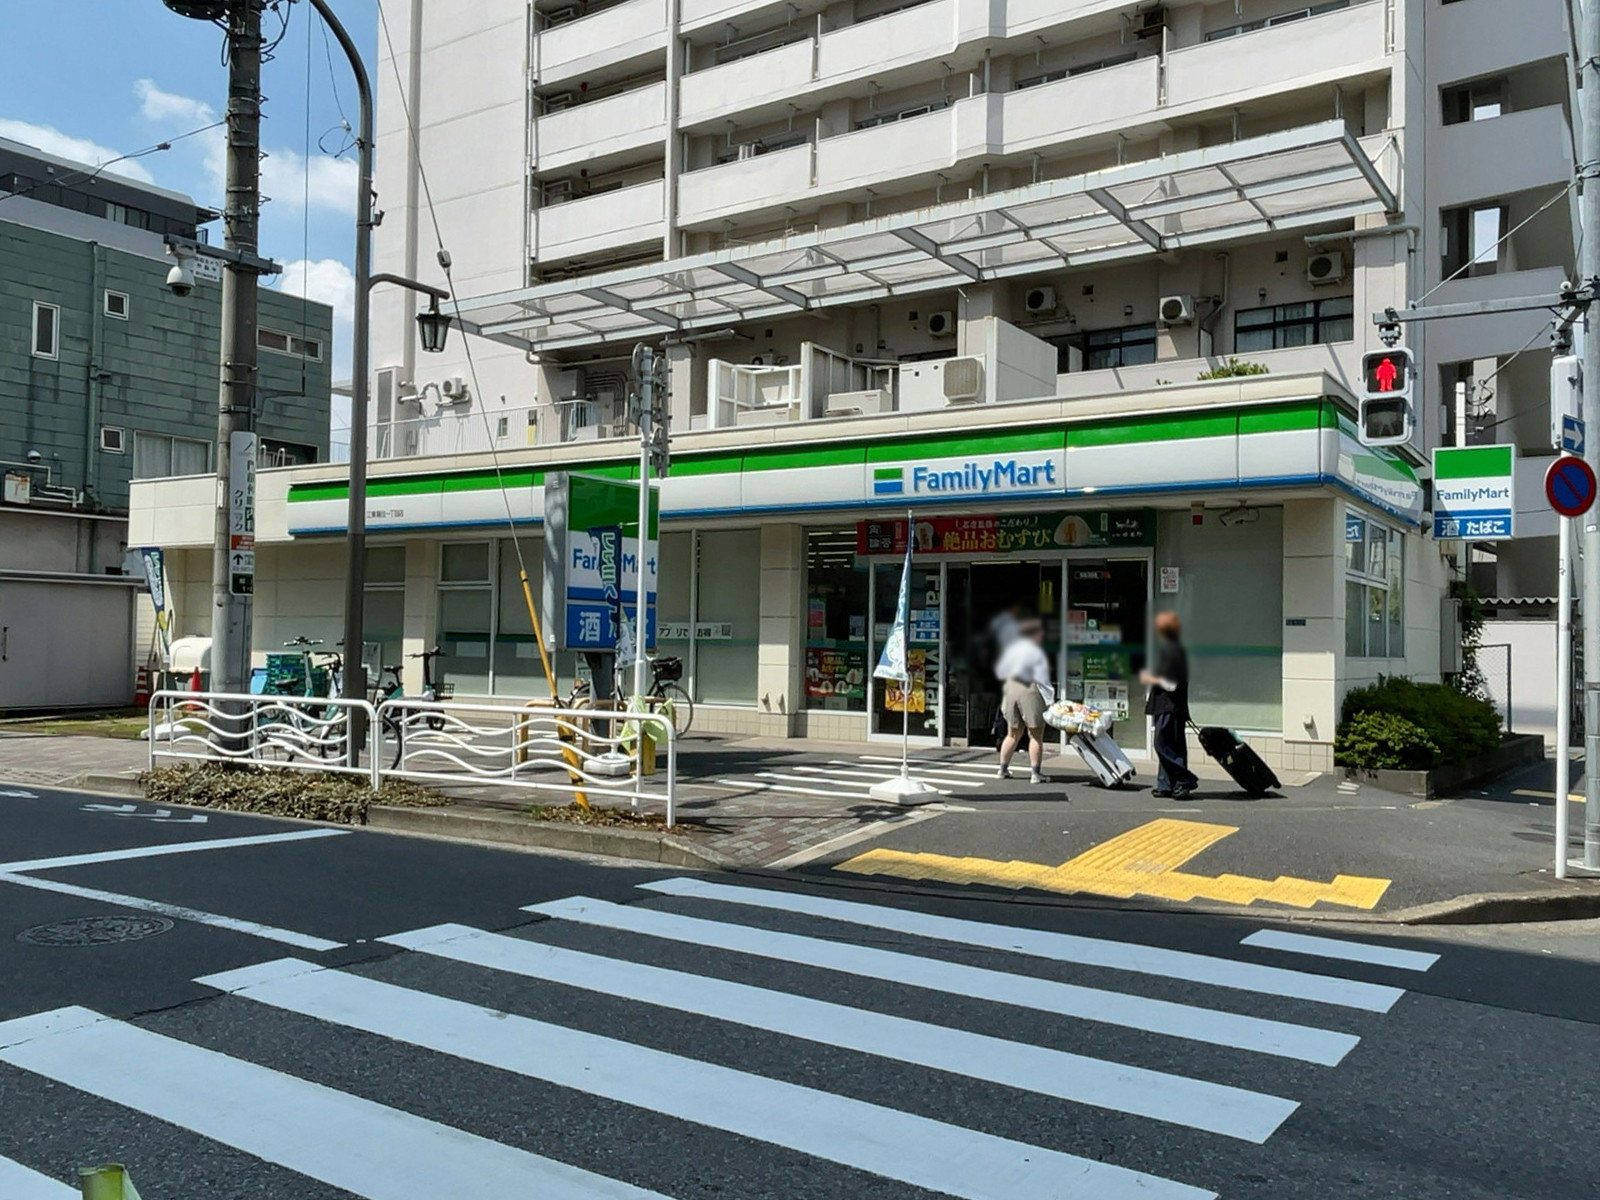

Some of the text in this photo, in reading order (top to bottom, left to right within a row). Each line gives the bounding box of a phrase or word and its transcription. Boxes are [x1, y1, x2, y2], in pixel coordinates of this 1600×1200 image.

[913, 459, 1056, 492] FamilyMart
[1437, 487, 1510, 502] FamilyMart
[234, 489, 244, 531] クリニック
[943, 528, 1051, 550] 絶品おむすび
[1441, 520, 1505, 536] 酒 たばこ
[579, 611, 601, 642] 酒
